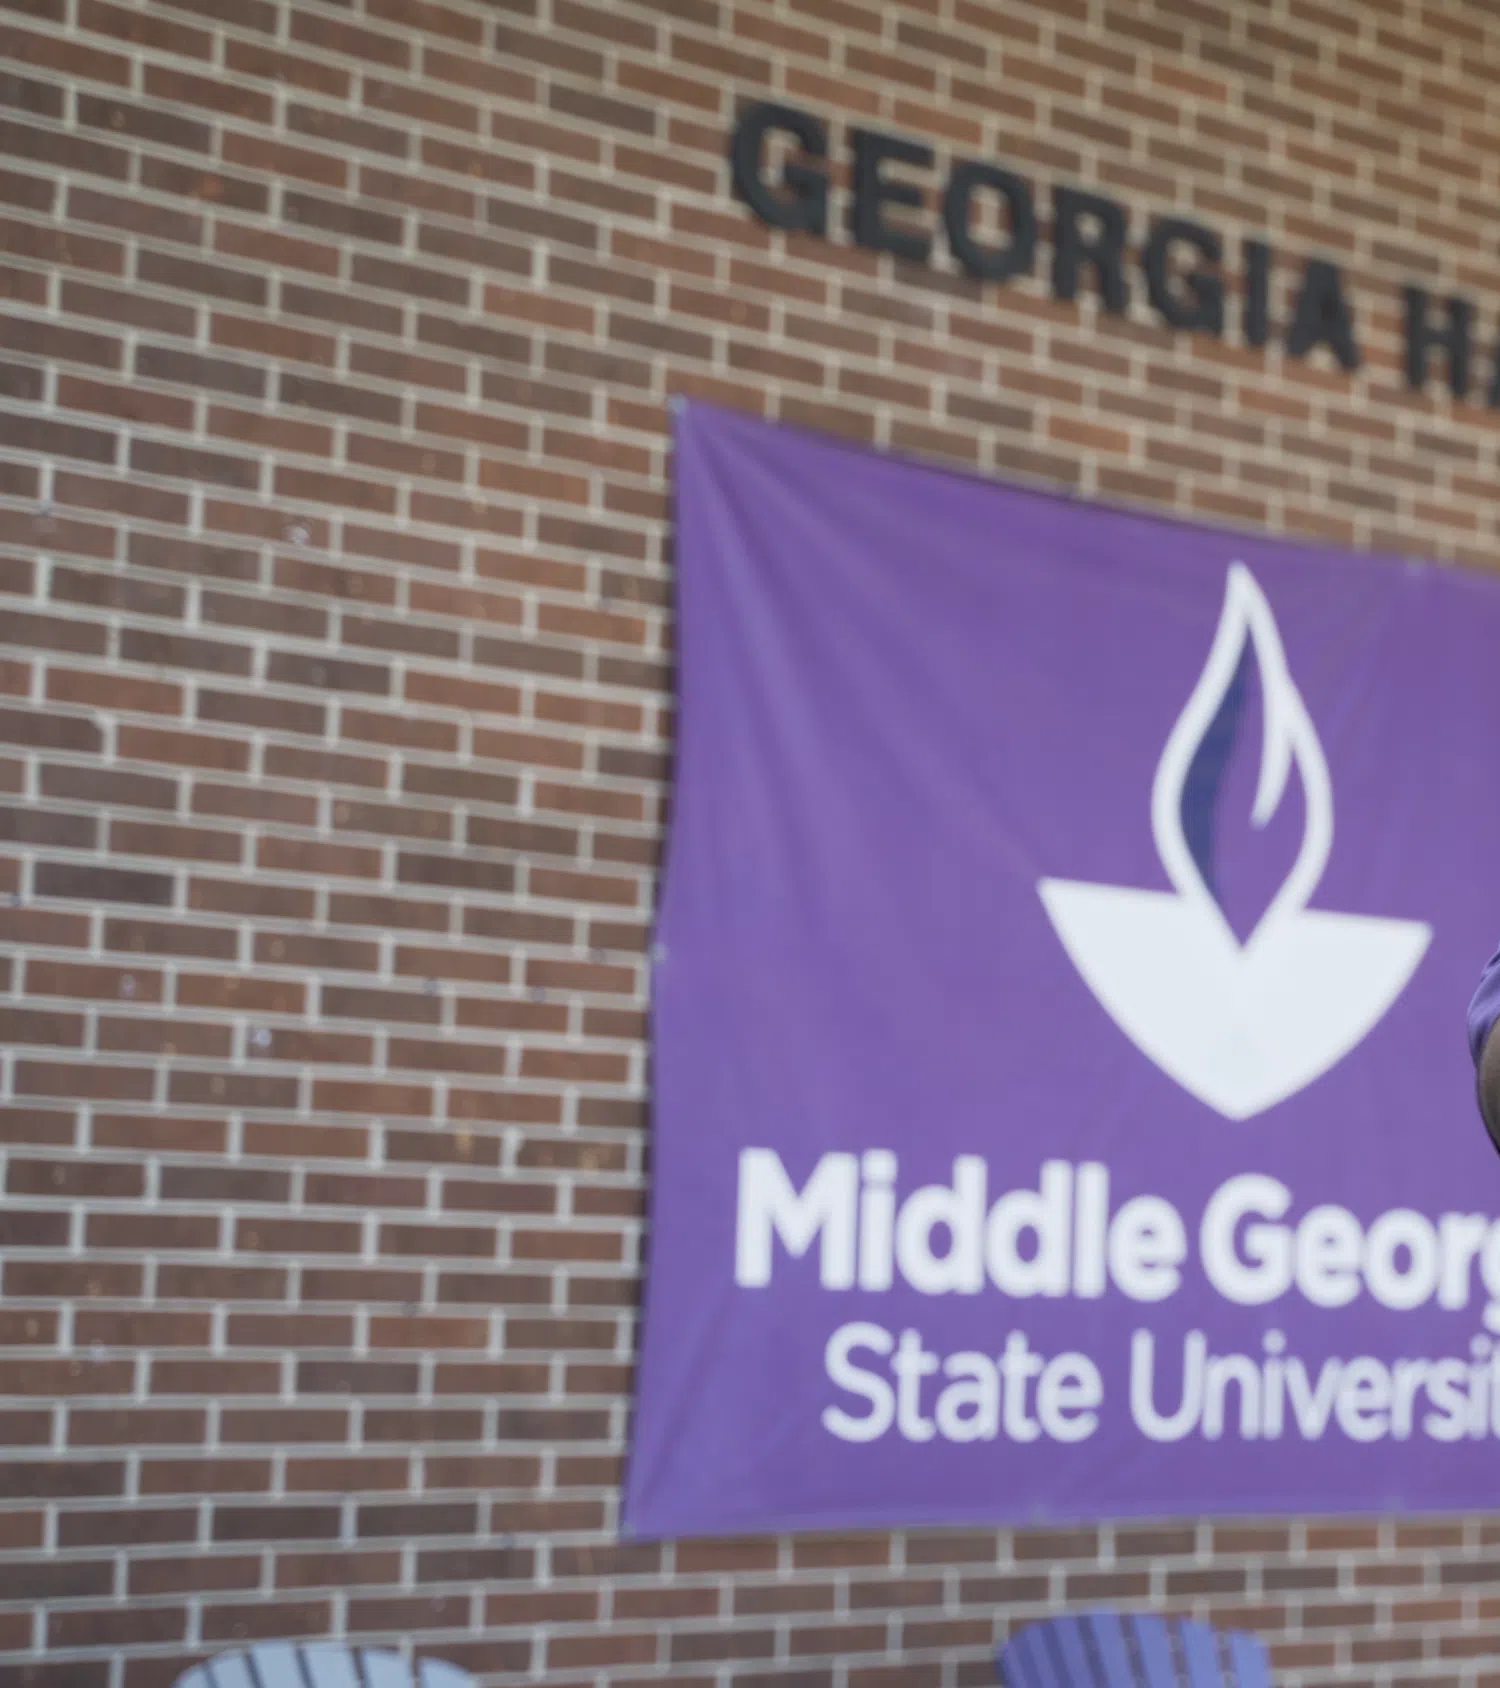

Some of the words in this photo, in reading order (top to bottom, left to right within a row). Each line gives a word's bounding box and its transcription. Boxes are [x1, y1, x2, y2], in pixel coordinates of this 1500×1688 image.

[730, 101, 1360, 373] GEORGIA
[735, 1147, 1188, 1302] Middle
[821, 1321, 1103, 1443] State
